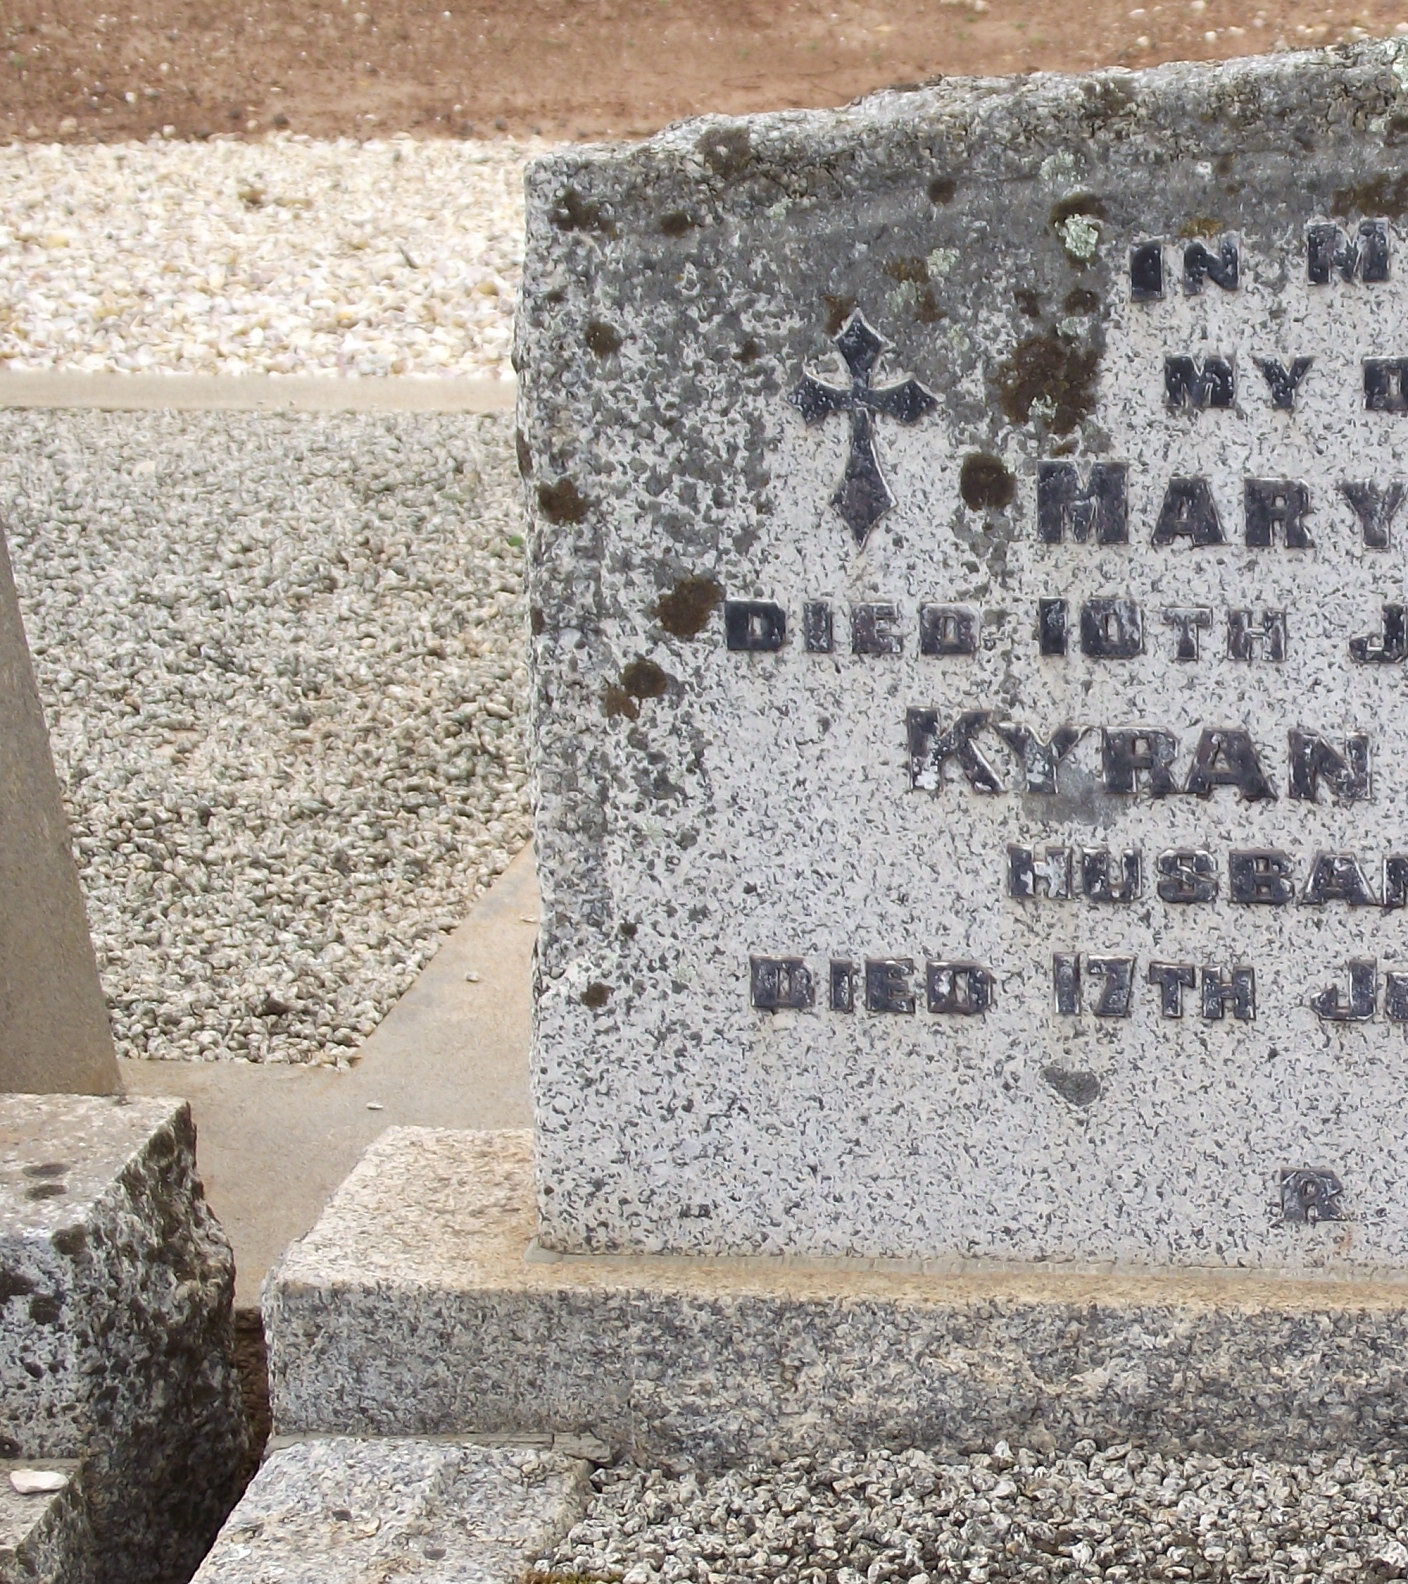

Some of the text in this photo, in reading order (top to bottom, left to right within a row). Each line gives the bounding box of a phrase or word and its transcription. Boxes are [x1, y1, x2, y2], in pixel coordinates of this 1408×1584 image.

[1131, 236, 1240, 299] IN
[1164, 353, 1312, 410] MY
[724, 601, 982, 655] DIED
[1038, 598, 1288, 662] 10TH
[906, 706, 1373, 801] KYRAN
[749, 953, 992, 1016] DIED
[1052, 951, 1256, 1022] 17TH
